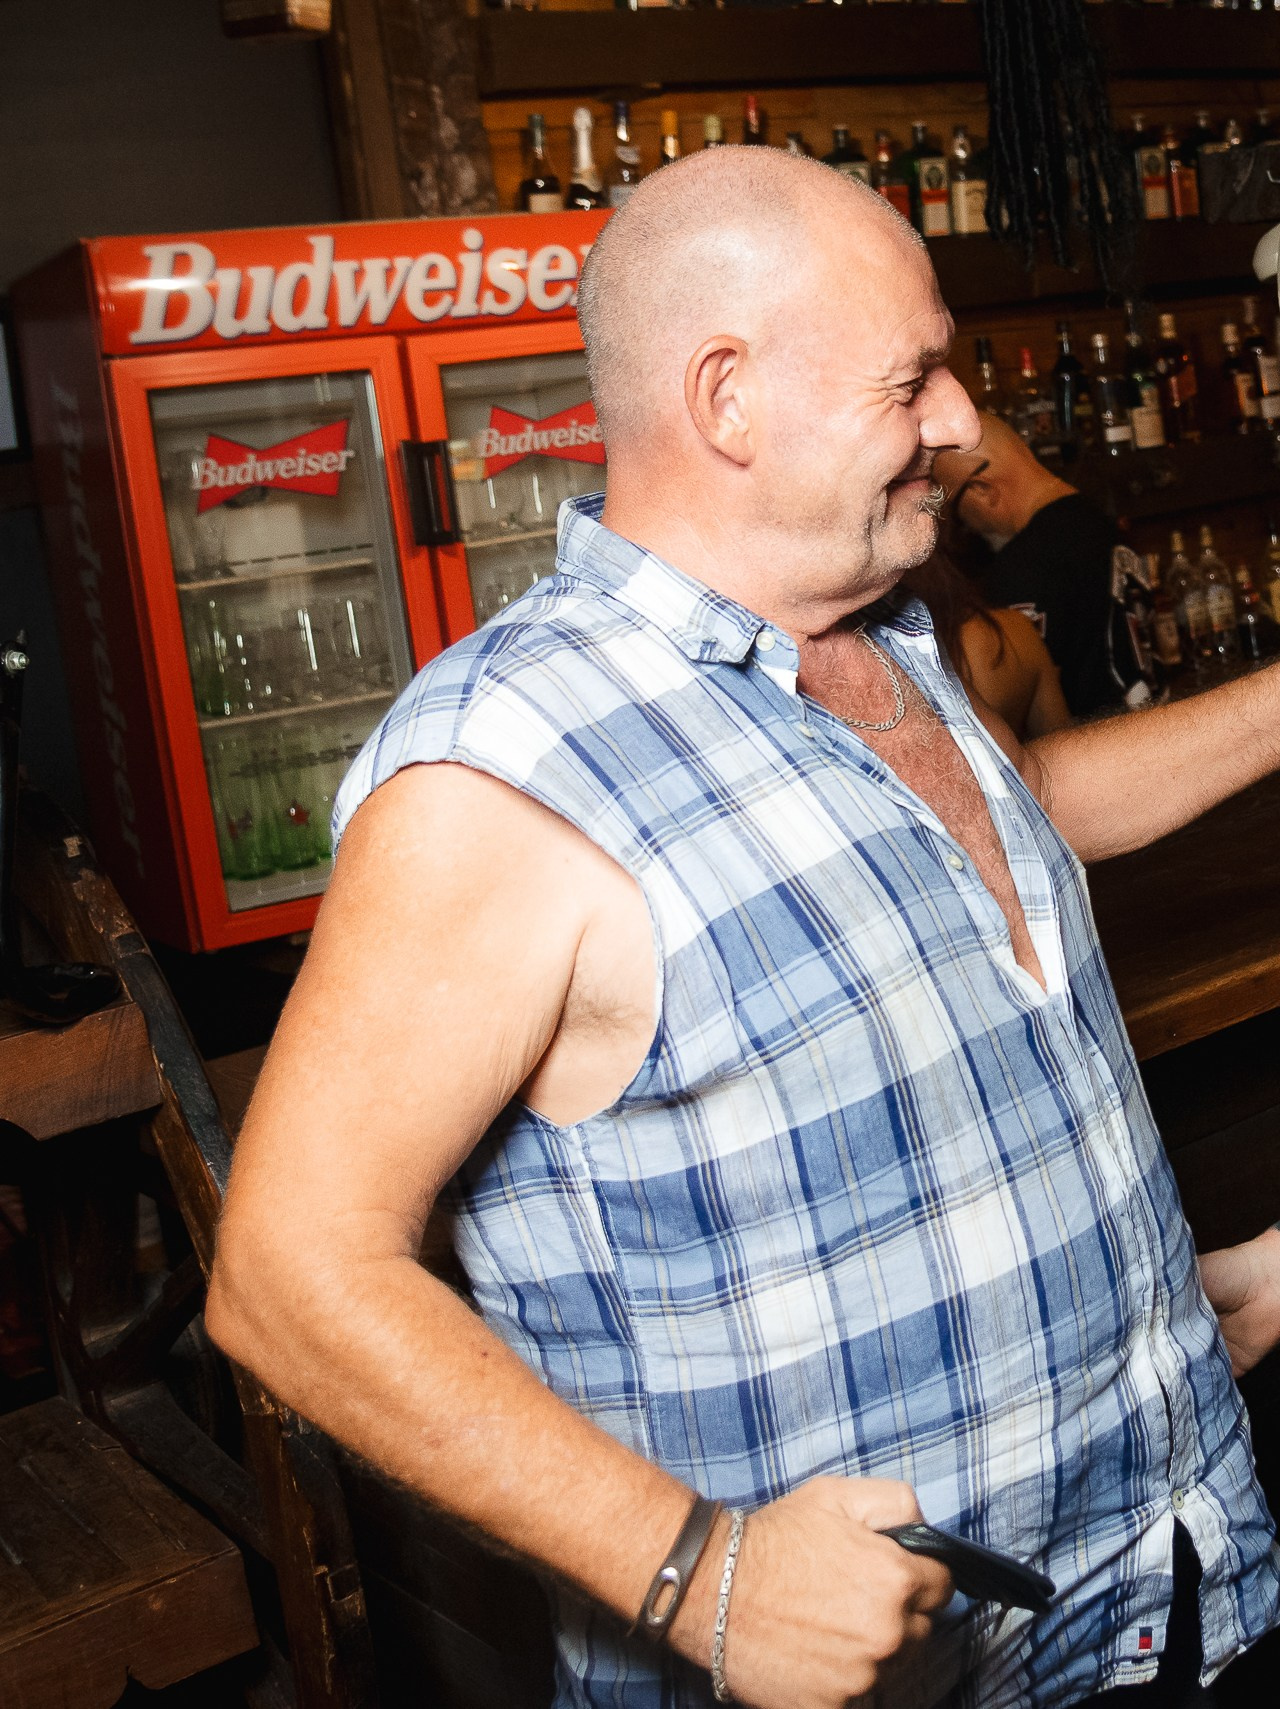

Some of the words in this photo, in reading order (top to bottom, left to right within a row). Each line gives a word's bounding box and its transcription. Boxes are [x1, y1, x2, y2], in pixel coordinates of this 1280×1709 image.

[128, 228, 593, 346] Budweise
[478, 419, 604, 459] Budweise
[191, 447, 356, 492] Budweiser
